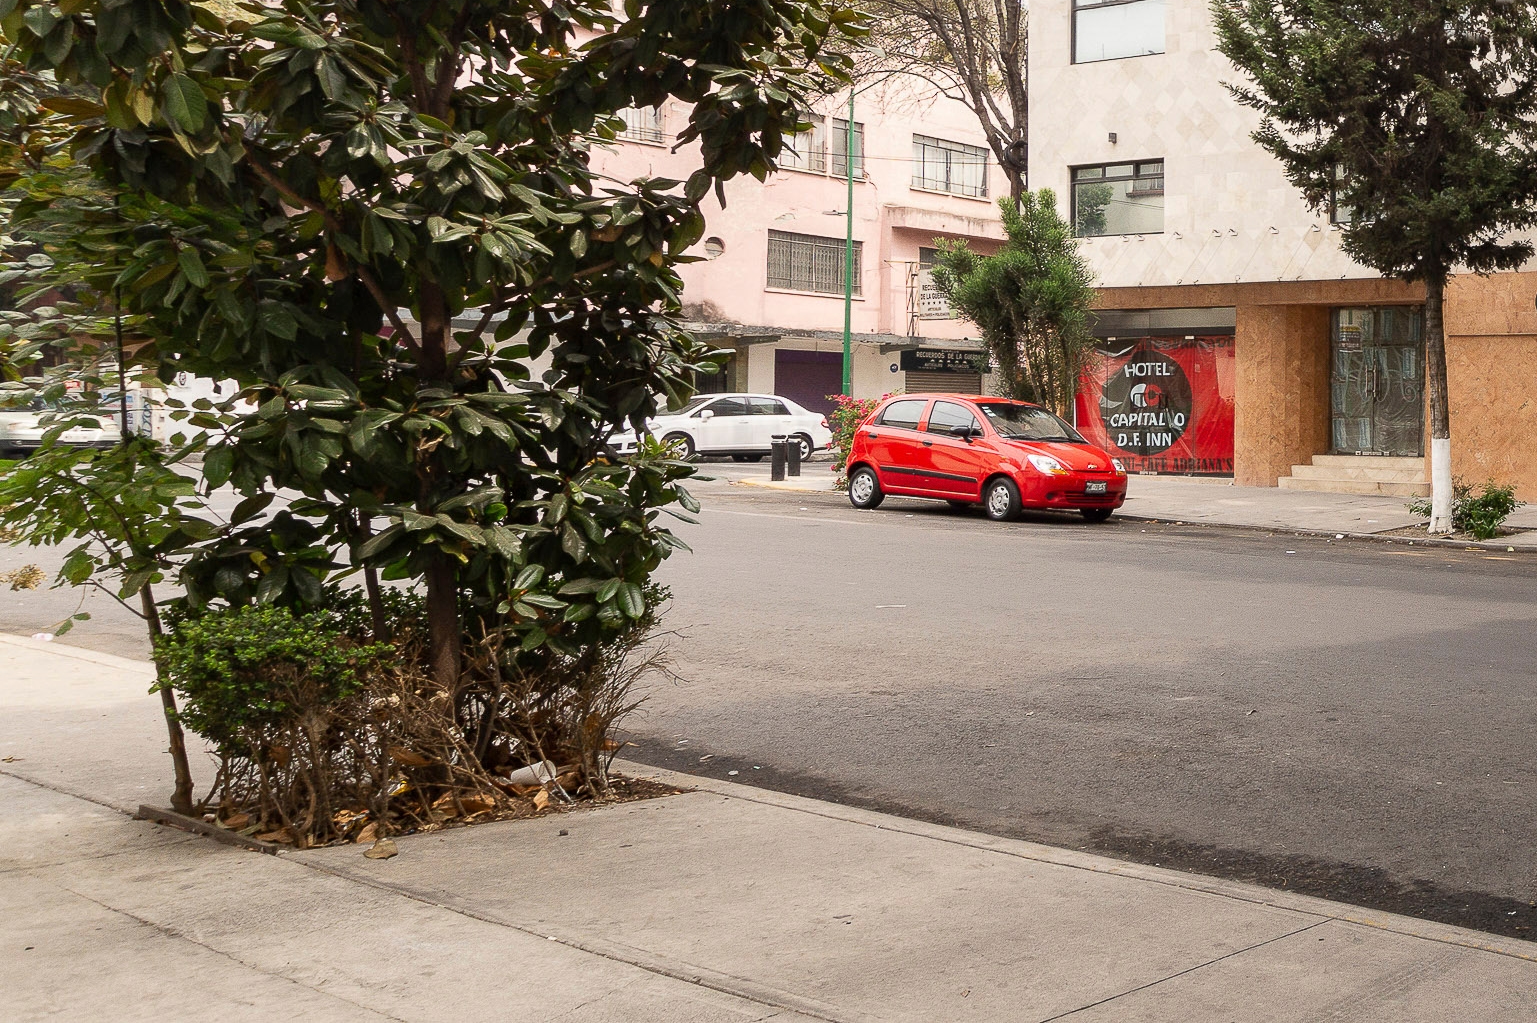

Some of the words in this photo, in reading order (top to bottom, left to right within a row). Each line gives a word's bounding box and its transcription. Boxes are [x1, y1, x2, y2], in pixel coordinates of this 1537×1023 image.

[916, 351, 945, 359] RECUERDOS
[1124, 362, 1171, 377] HOTEL
[1110, 412, 1165, 427] CAPITAL
[1174, 412, 1185, 427] O
[1117, 433, 1141, 447] D.F.
[1146, 432, 1172, 447] INN
